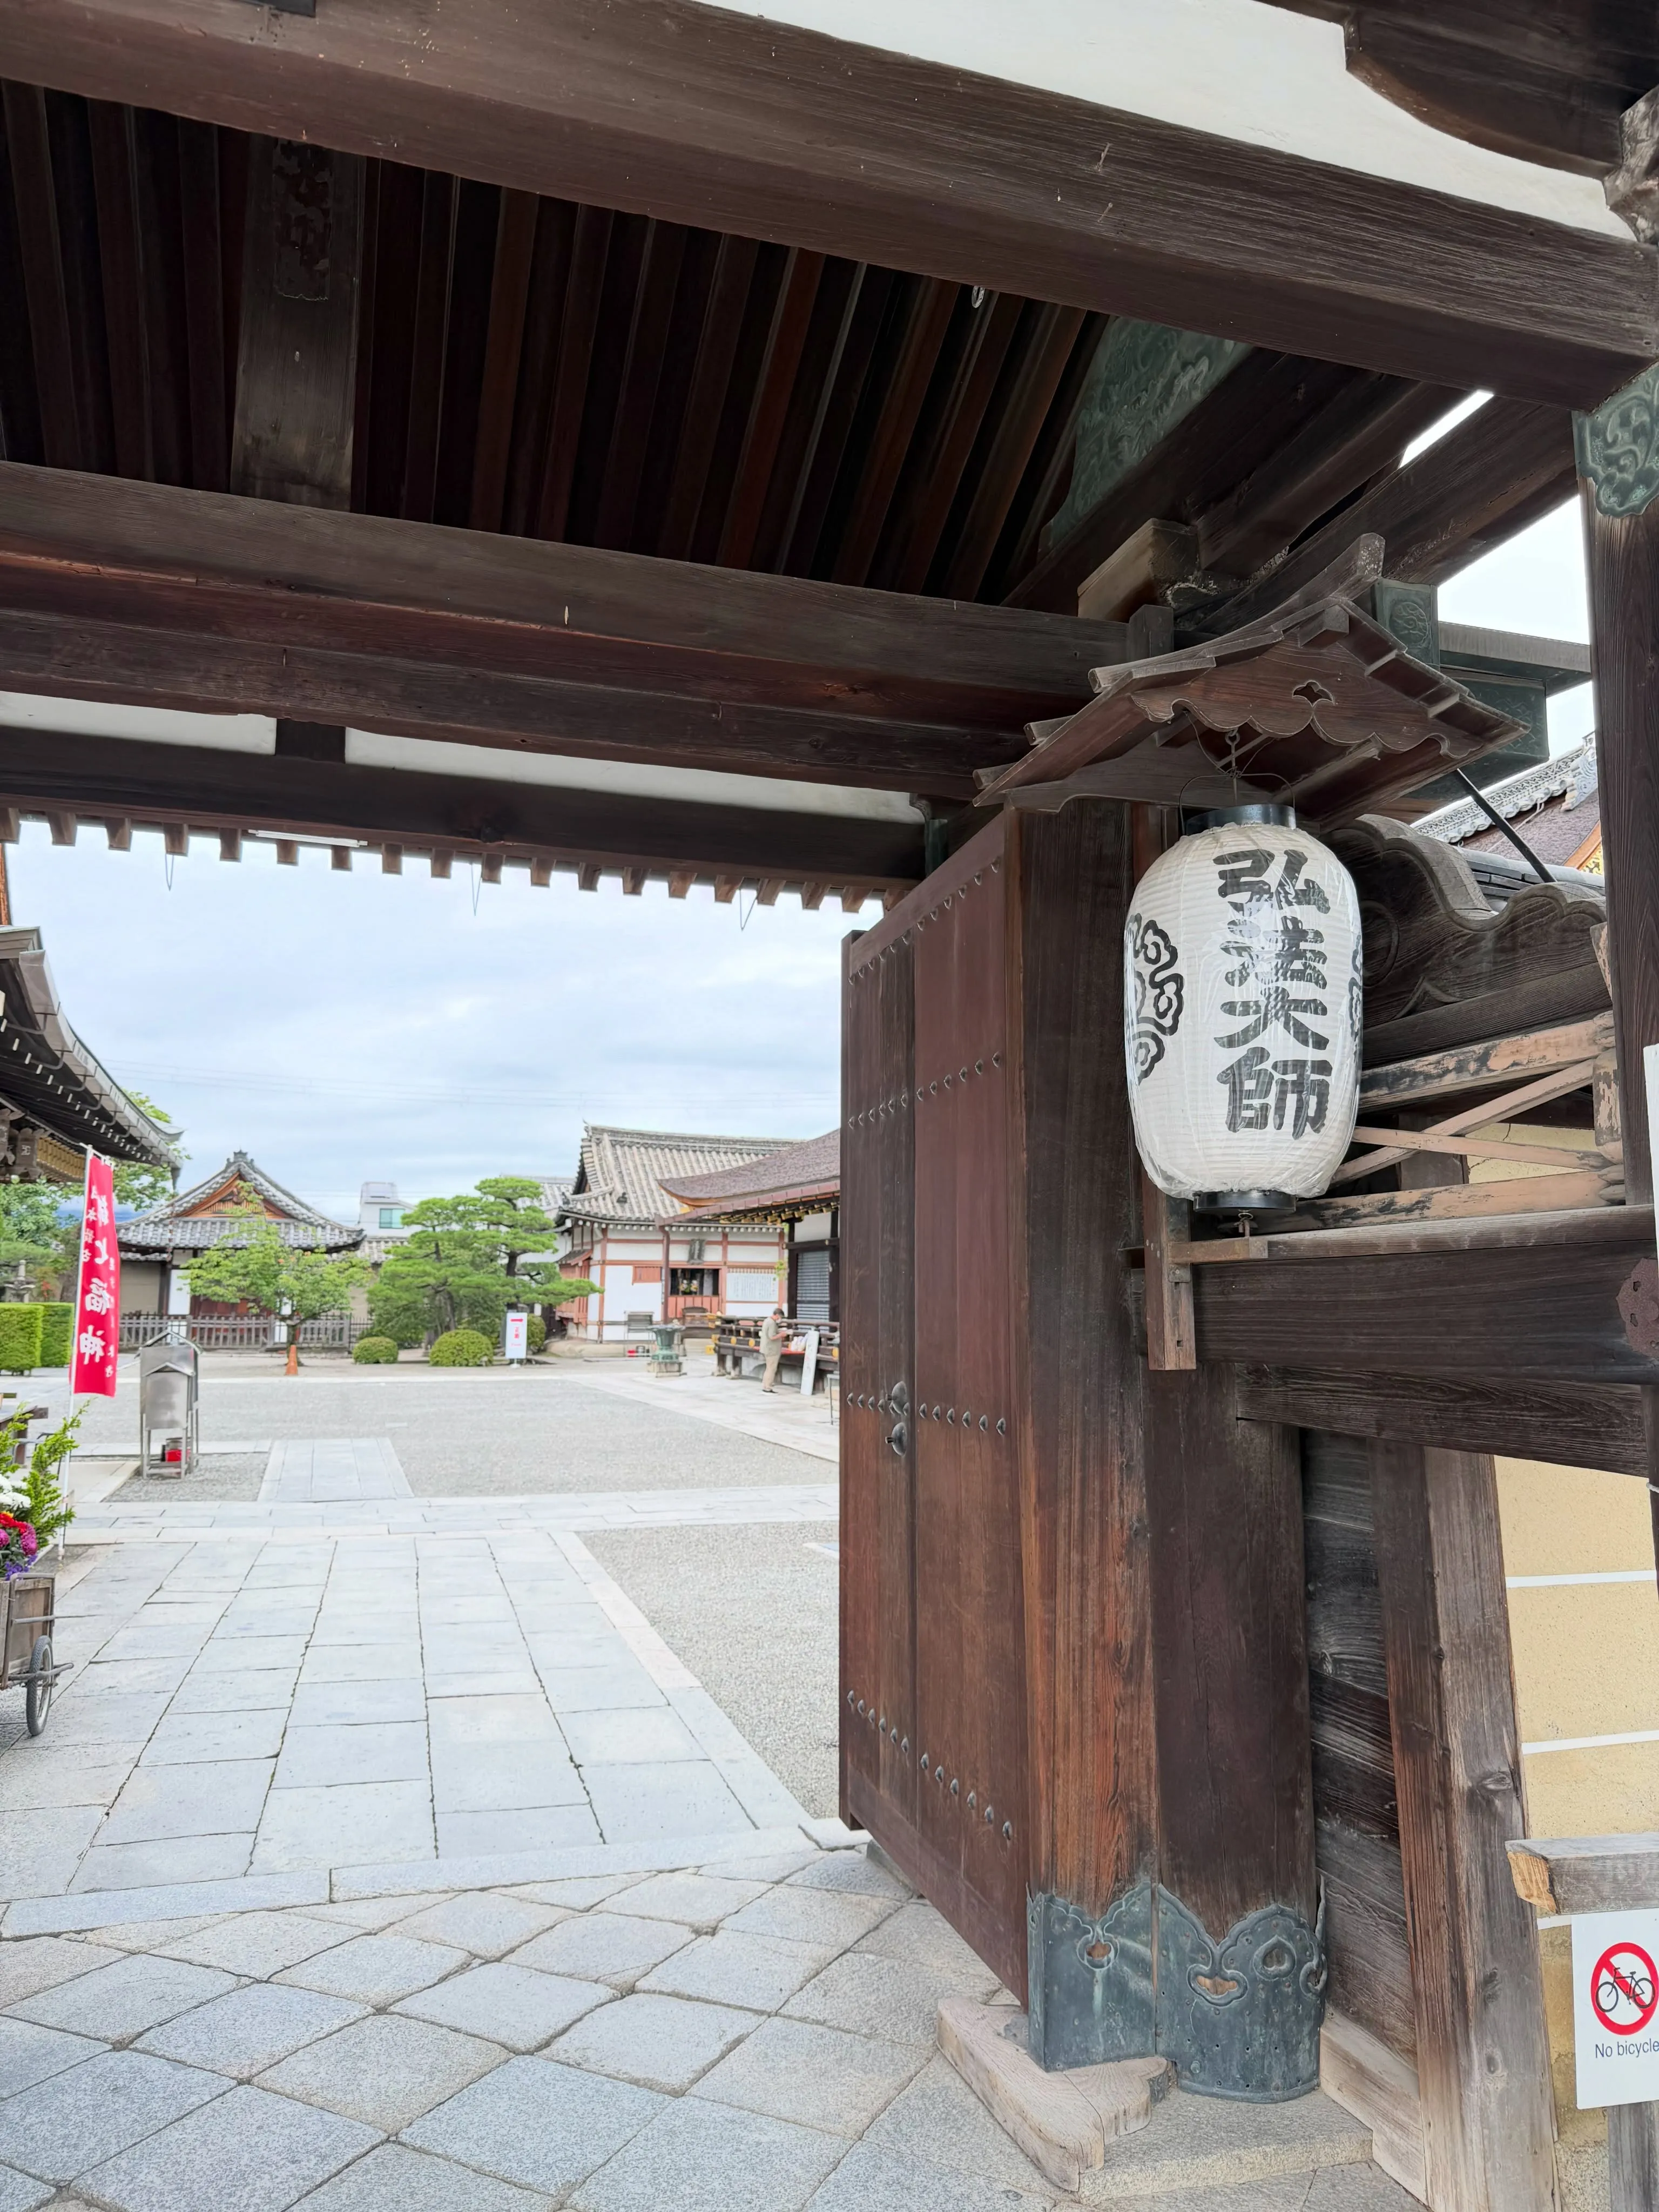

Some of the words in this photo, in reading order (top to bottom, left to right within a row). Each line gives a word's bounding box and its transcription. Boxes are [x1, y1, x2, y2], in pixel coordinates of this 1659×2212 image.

[1213, 849, 1332, 1141] 弘法大師
[1595, 2043, 1613, 2058] No
[1617, 2038, 1659, 2058] bicycle
